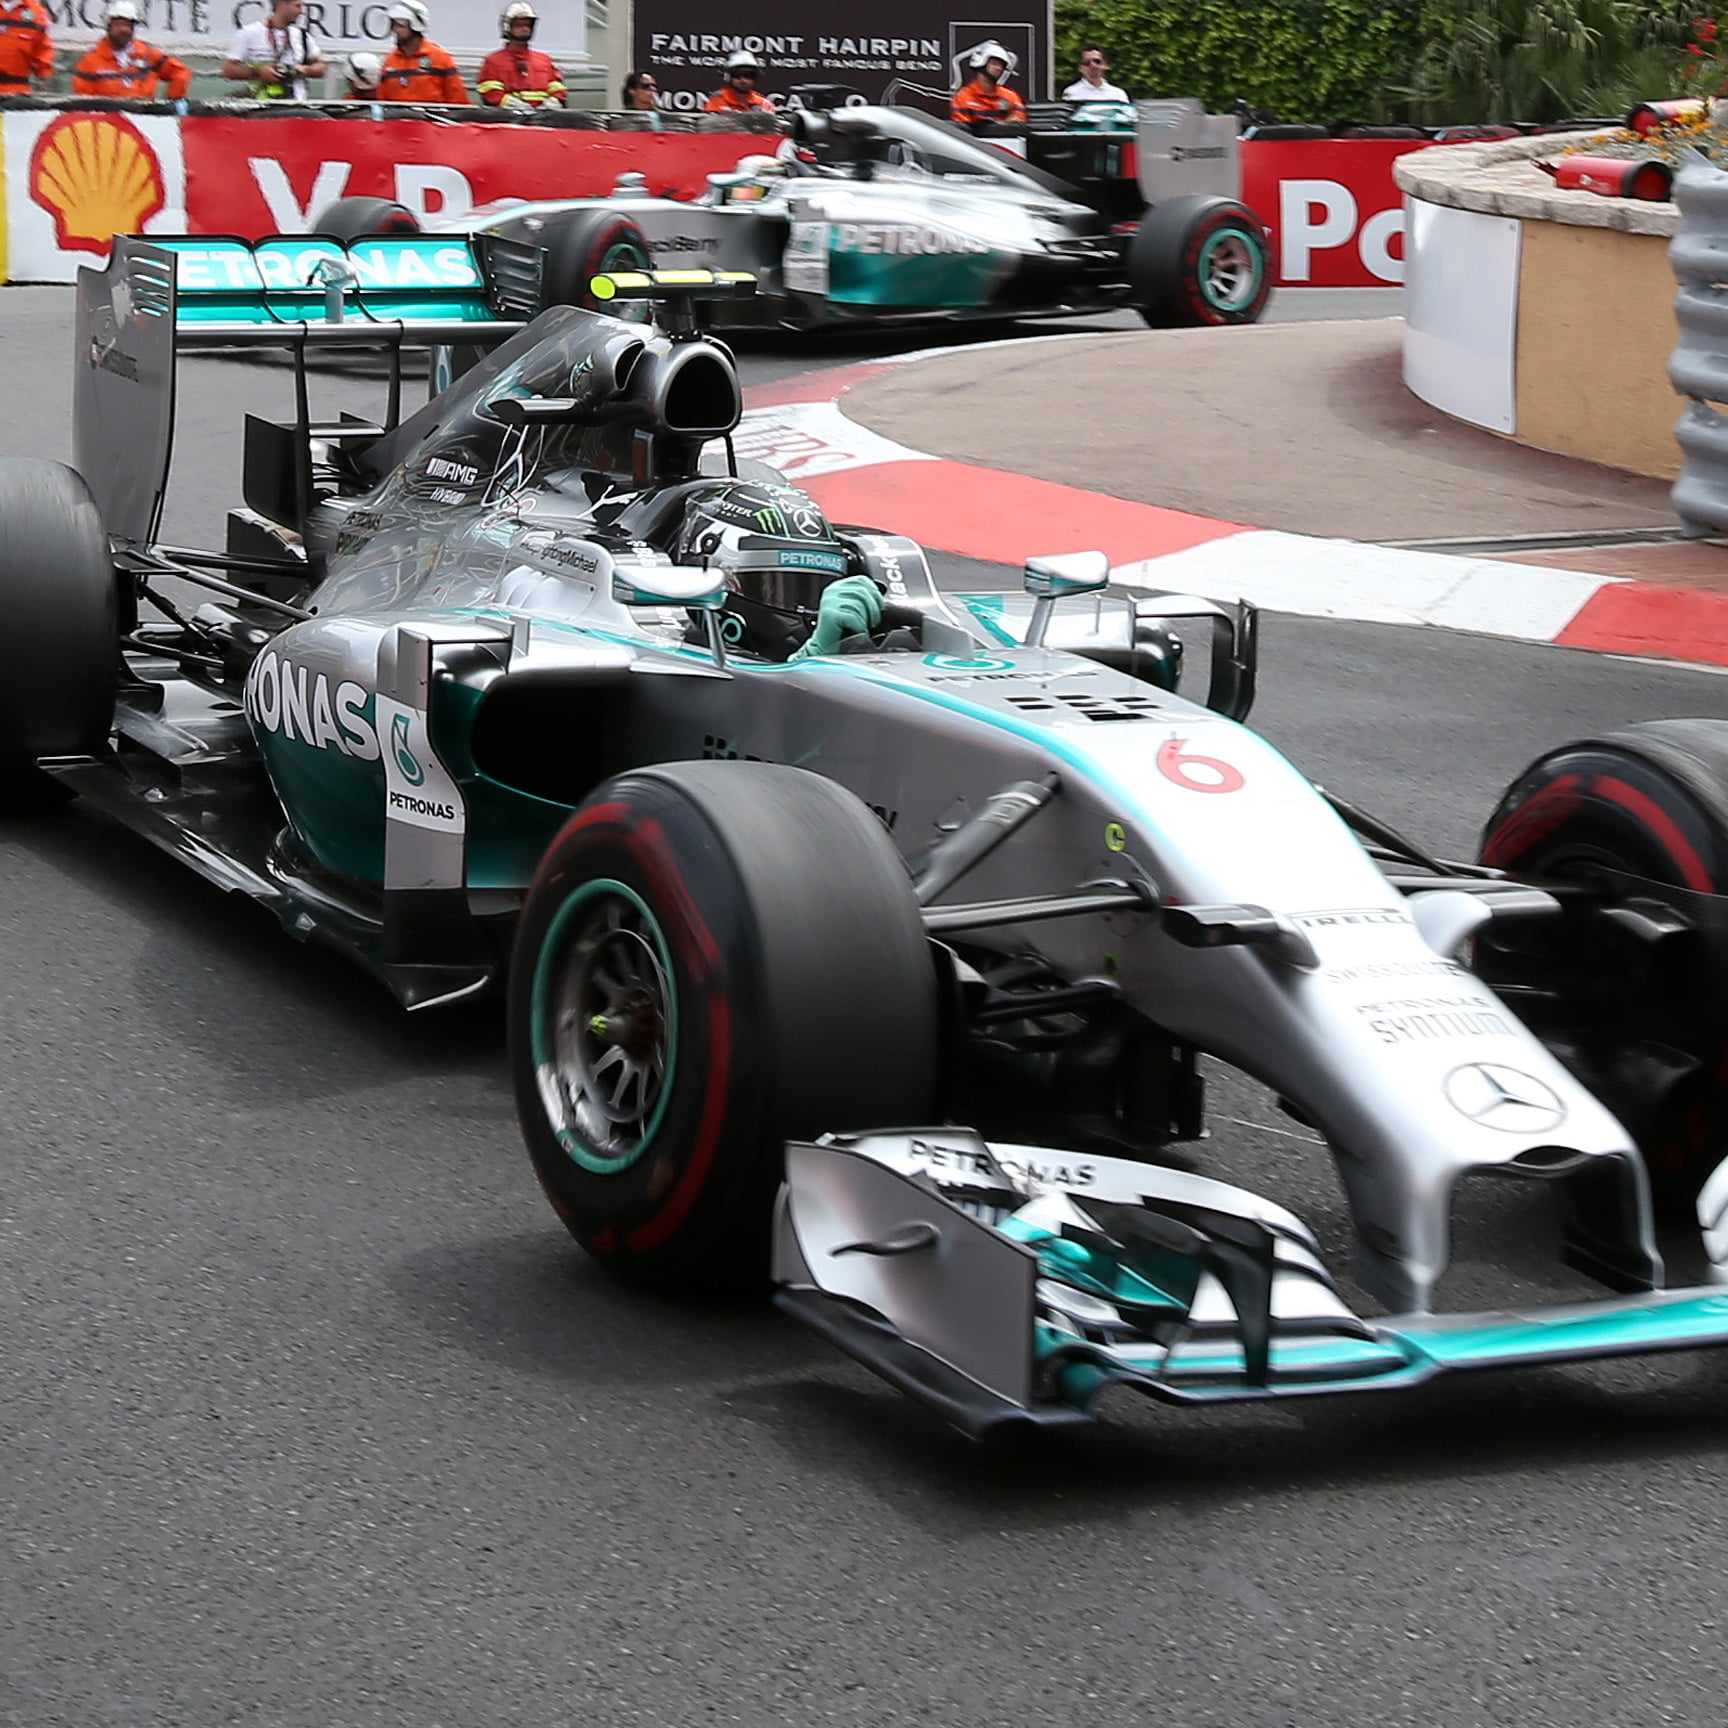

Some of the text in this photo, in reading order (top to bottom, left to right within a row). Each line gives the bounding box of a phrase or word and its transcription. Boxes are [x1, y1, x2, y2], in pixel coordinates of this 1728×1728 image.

[232, 0, 393, 40] CRLO
[650, 33, 941, 57] FAIRMONT HAIRPIN
[649, 55, 685, 66] THE
[688, 56, 767, 68] WORS
[770, 57, 818, 69] MOST
[822, 58, 891, 70] FAMOUS
[653, 90, 870, 112] MON CAO
[442, 461, 479, 486] AMG
[780, 550, 843, 572] PETRONAS
[1156, 738, 1246, 794] 6
[389, 790, 455, 821] PETRONAS
